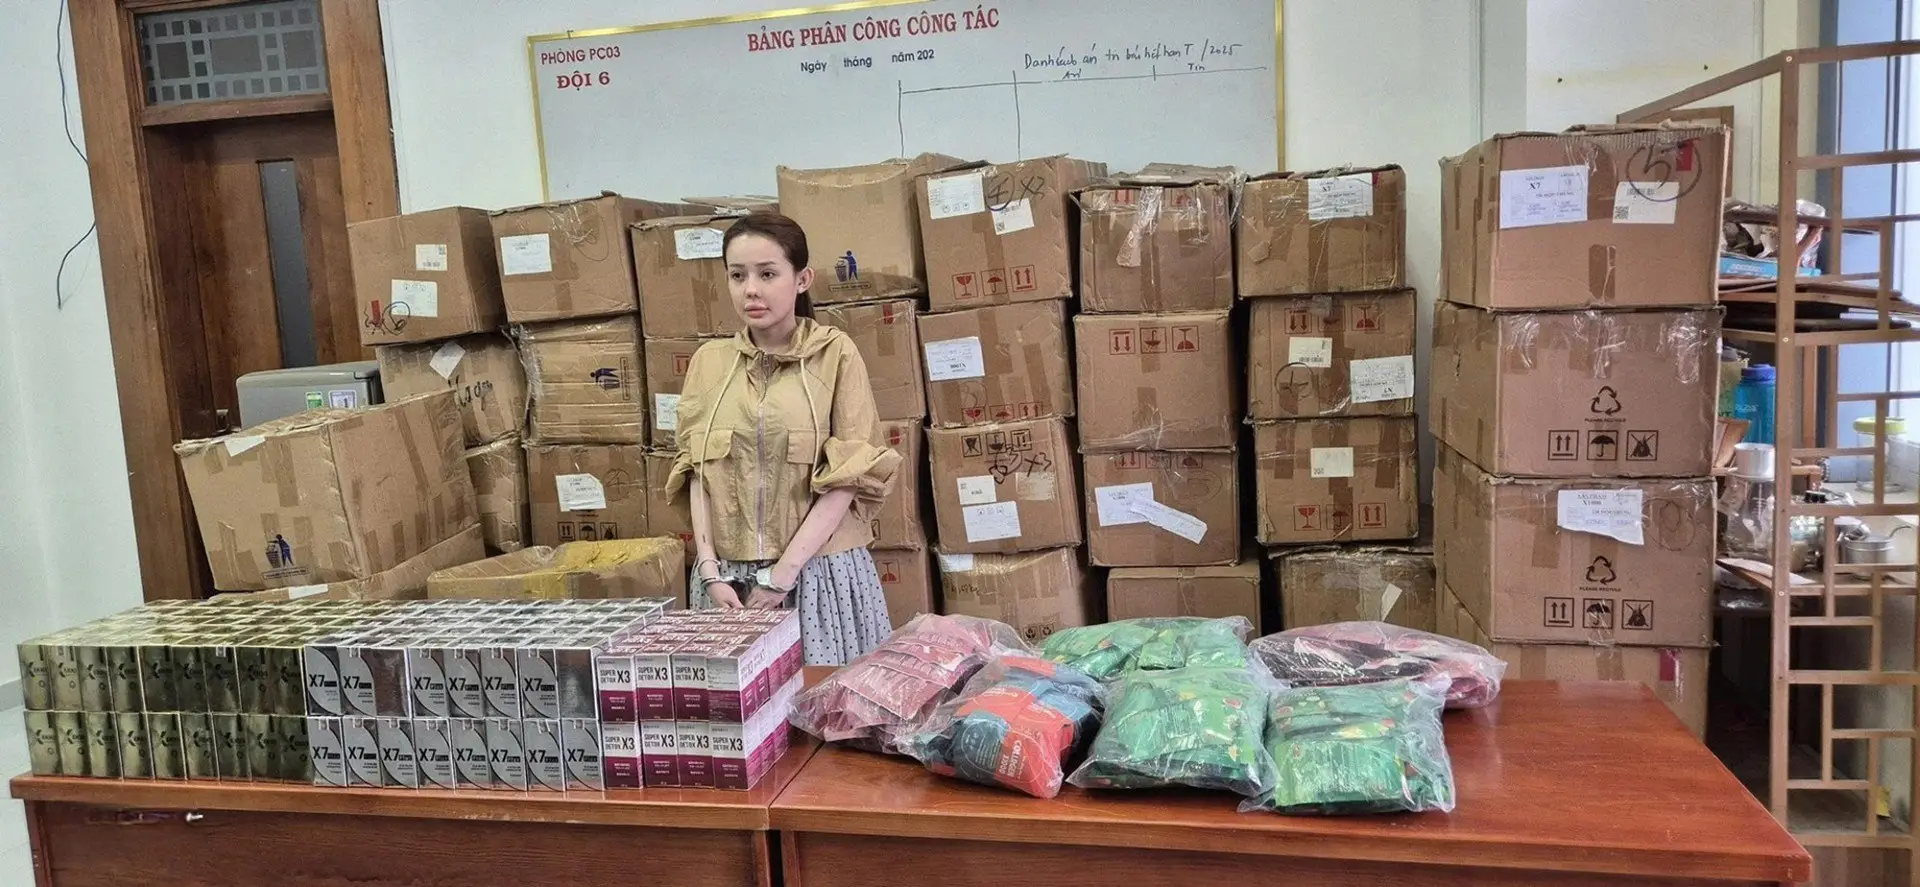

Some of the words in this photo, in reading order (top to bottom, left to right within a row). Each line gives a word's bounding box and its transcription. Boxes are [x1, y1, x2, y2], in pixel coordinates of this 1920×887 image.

[748, 25, 795, 51] BẢNG
[800, 21, 846, 46] PHÂN
[853, 16, 901, 41] CÔNG
[907, 11, 957, 35] CÔNG
[963, 5, 1000, 30] TÁC
[541, 48, 586, 65] PHÒNG
[590, 46, 620, 60] PC03
[801, 60, 828, 73] Ngày
[843, 55, 872, 68] tháng
[892, 52, 915, 63] năm
[917, 50, 935, 60] 202
[556, 70, 592, 91] ĐỘI
[599, 72, 611, 85] 6
[617, 670, 631, 683] X3
[654, 667, 668, 680] X3
[692, 668, 706, 681] X3
[309, 674, 325, 687] X7
[343, 676, 360, 689] X7
[414, 677, 431, 690] X7
[449, 677, 466, 691] X7
[484, 676, 502, 690] X7
[524, 678, 542, 692] X7
[622, 737, 635, 750] X3
[660, 734, 674, 748] X3
[696, 735, 709, 748] X3
[729, 738, 743, 751] X3
[313, 747, 328, 760] X7
[348, 747, 364, 760] X7
[383, 748, 400, 761] X7
[420, 748, 436, 761] X7
[456, 748, 473, 761] X7
[491, 749, 508, 762] X7
[529, 749, 546, 763] X7
[567, 748, 585, 762] X7
